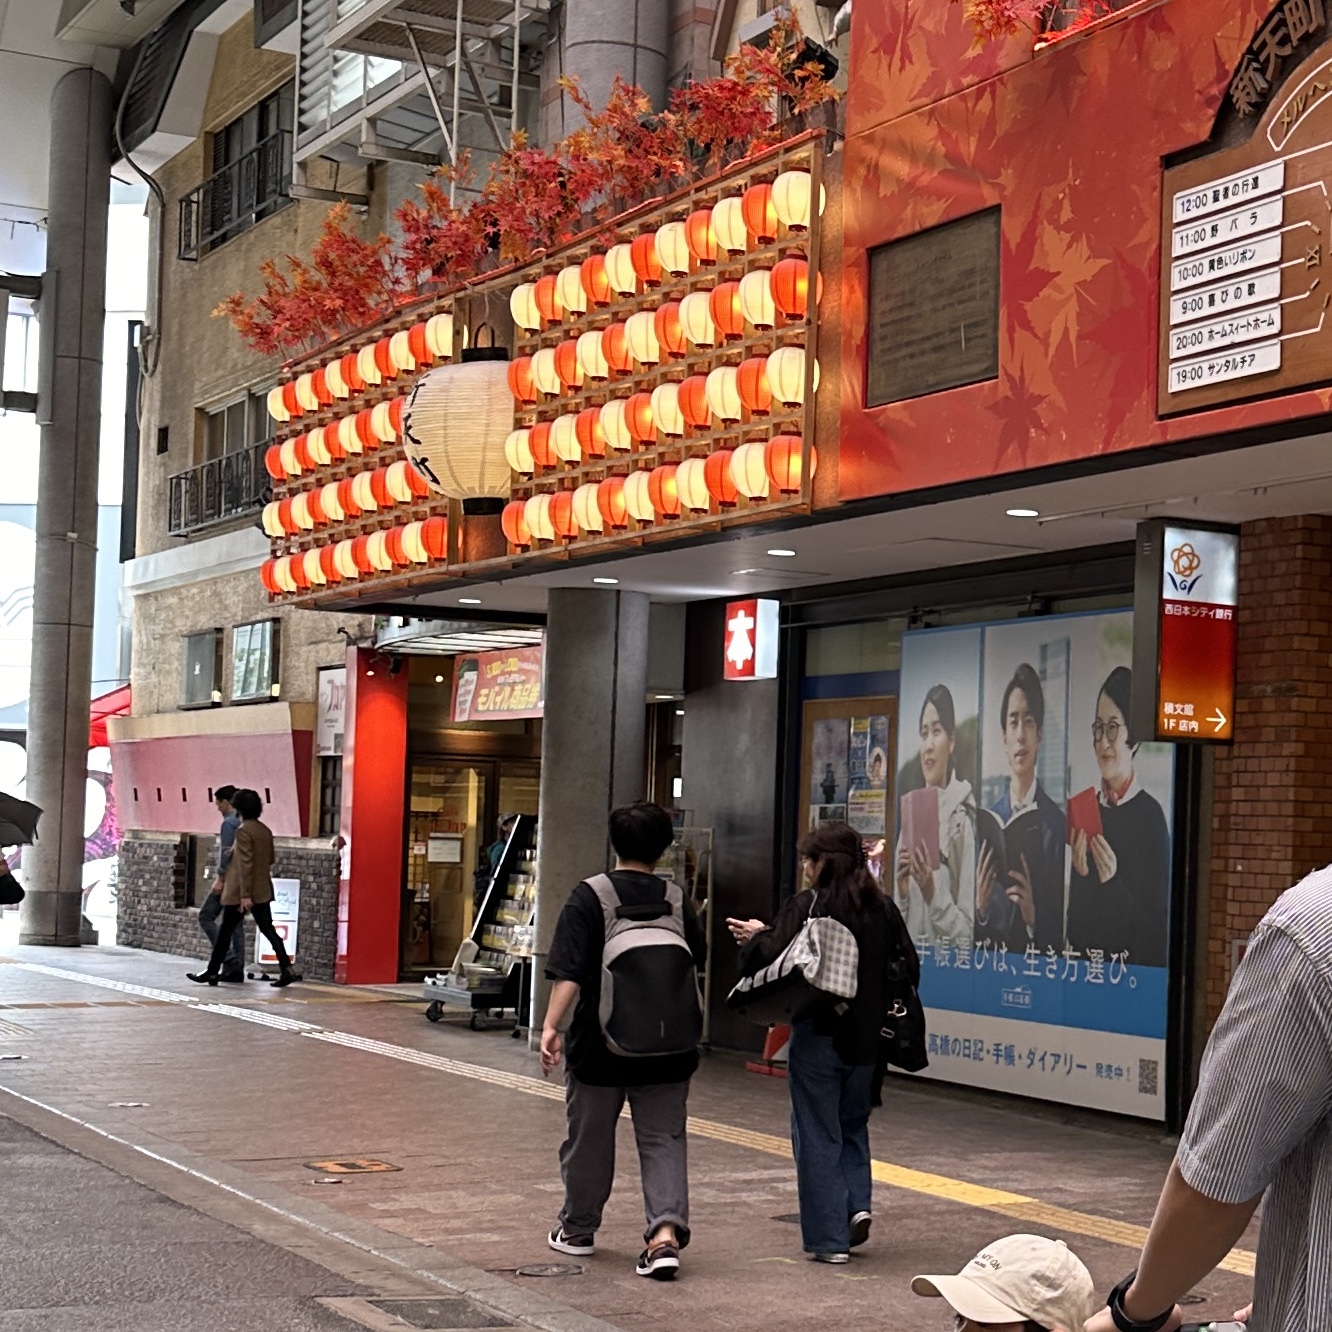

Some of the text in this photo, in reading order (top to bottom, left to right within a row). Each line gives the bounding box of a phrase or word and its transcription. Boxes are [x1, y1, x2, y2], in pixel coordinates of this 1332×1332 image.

[1180, 193, 1208, 215] 12:00
[1179, 227, 1206, 249] 11:00
[1177, 261, 1204, 282] 10:00
[1181, 297, 1204, 315] 9:00
[1176, 330, 1204, 351] 20:00
[1176, 352, 1256, 385] 19:00 サンタルチア
[1164, 603, 1234, 621] 西日本シティ銀行
[1163, 718, 1199, 733] 1F 店内
[915, 932, 1137, 989] 手帳選びは、生き方選び。
[928, 1033, 1087, 1076] 高橋の日記・手帳・ダイアリー
